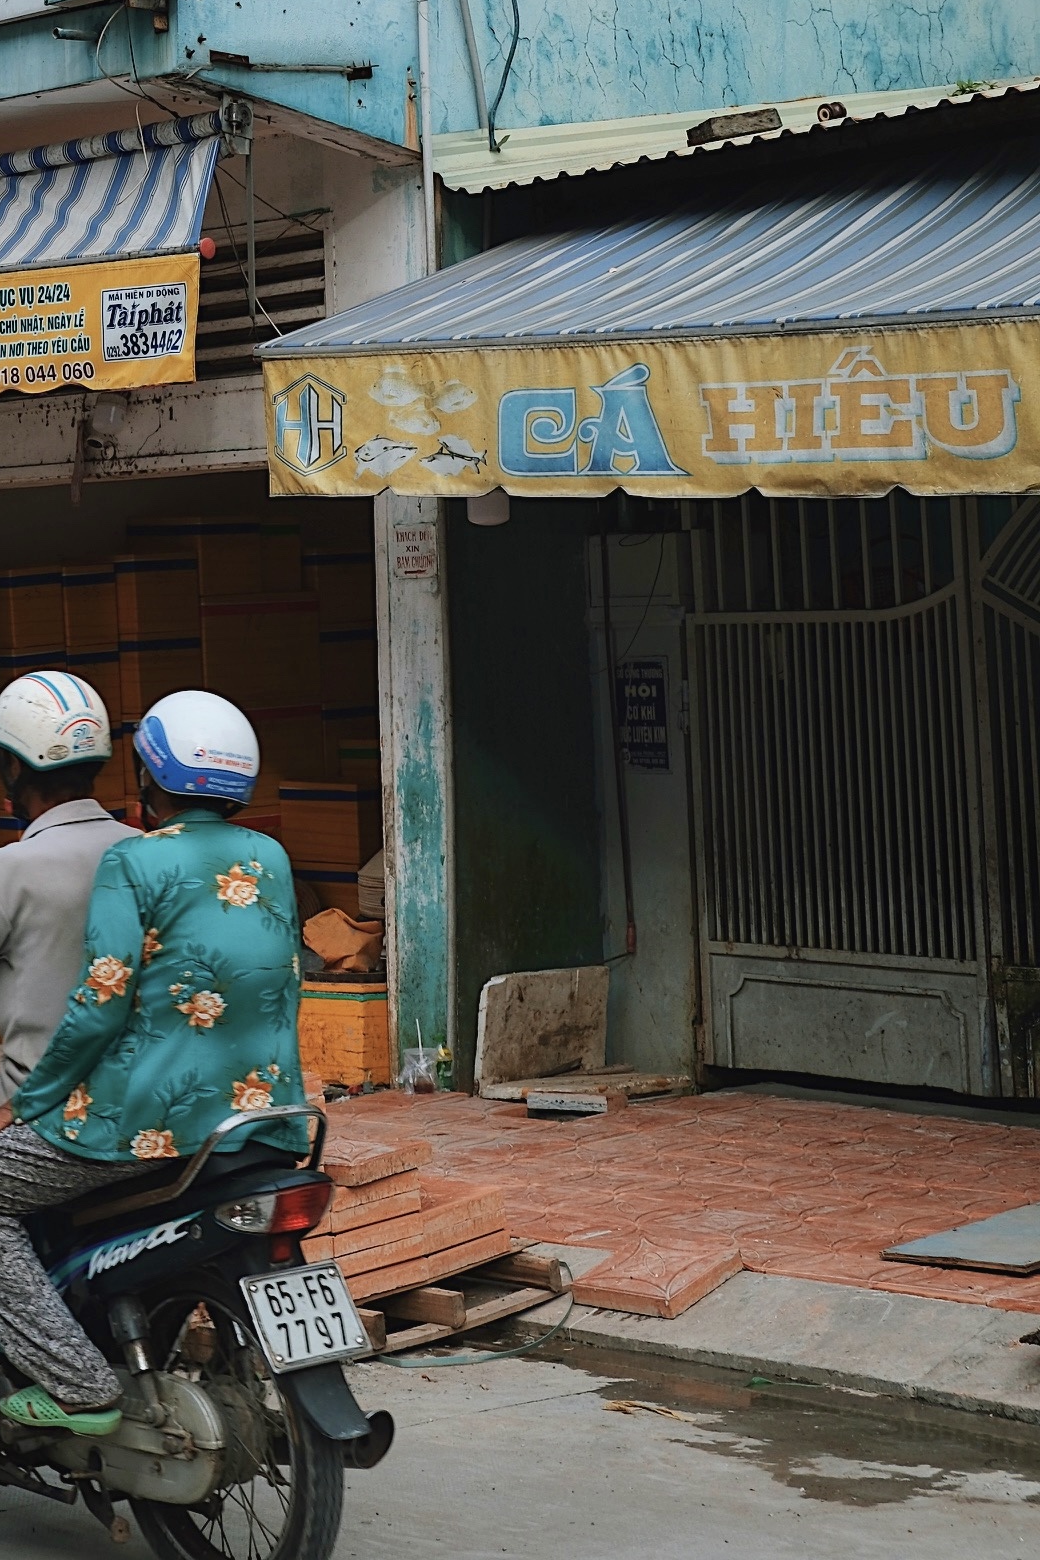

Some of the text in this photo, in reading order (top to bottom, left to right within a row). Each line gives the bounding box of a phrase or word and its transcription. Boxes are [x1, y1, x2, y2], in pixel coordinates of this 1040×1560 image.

[18, 286, 35, 309] VỤ
[37, 283, 71, 304] 24/24
[146, 290, 154, 298] DI
[0, 314, 18, 335] CHỦ
[47, 312, 72, 331] NGÀY
[8, 341, 25, 358] NƠI
[26, 340, 49, 356] THEO
[51, 336, 68, 354] YÊU
[25, 364, 57, 383] 044
[62, 361, 95, 381] 060
[498, 362, 694, 477] CÁ
[624, 682, 657, 700] HỘI
[640, 703, 656, 720] KHÍ
[277, 1312, 349, 1358] 7797
